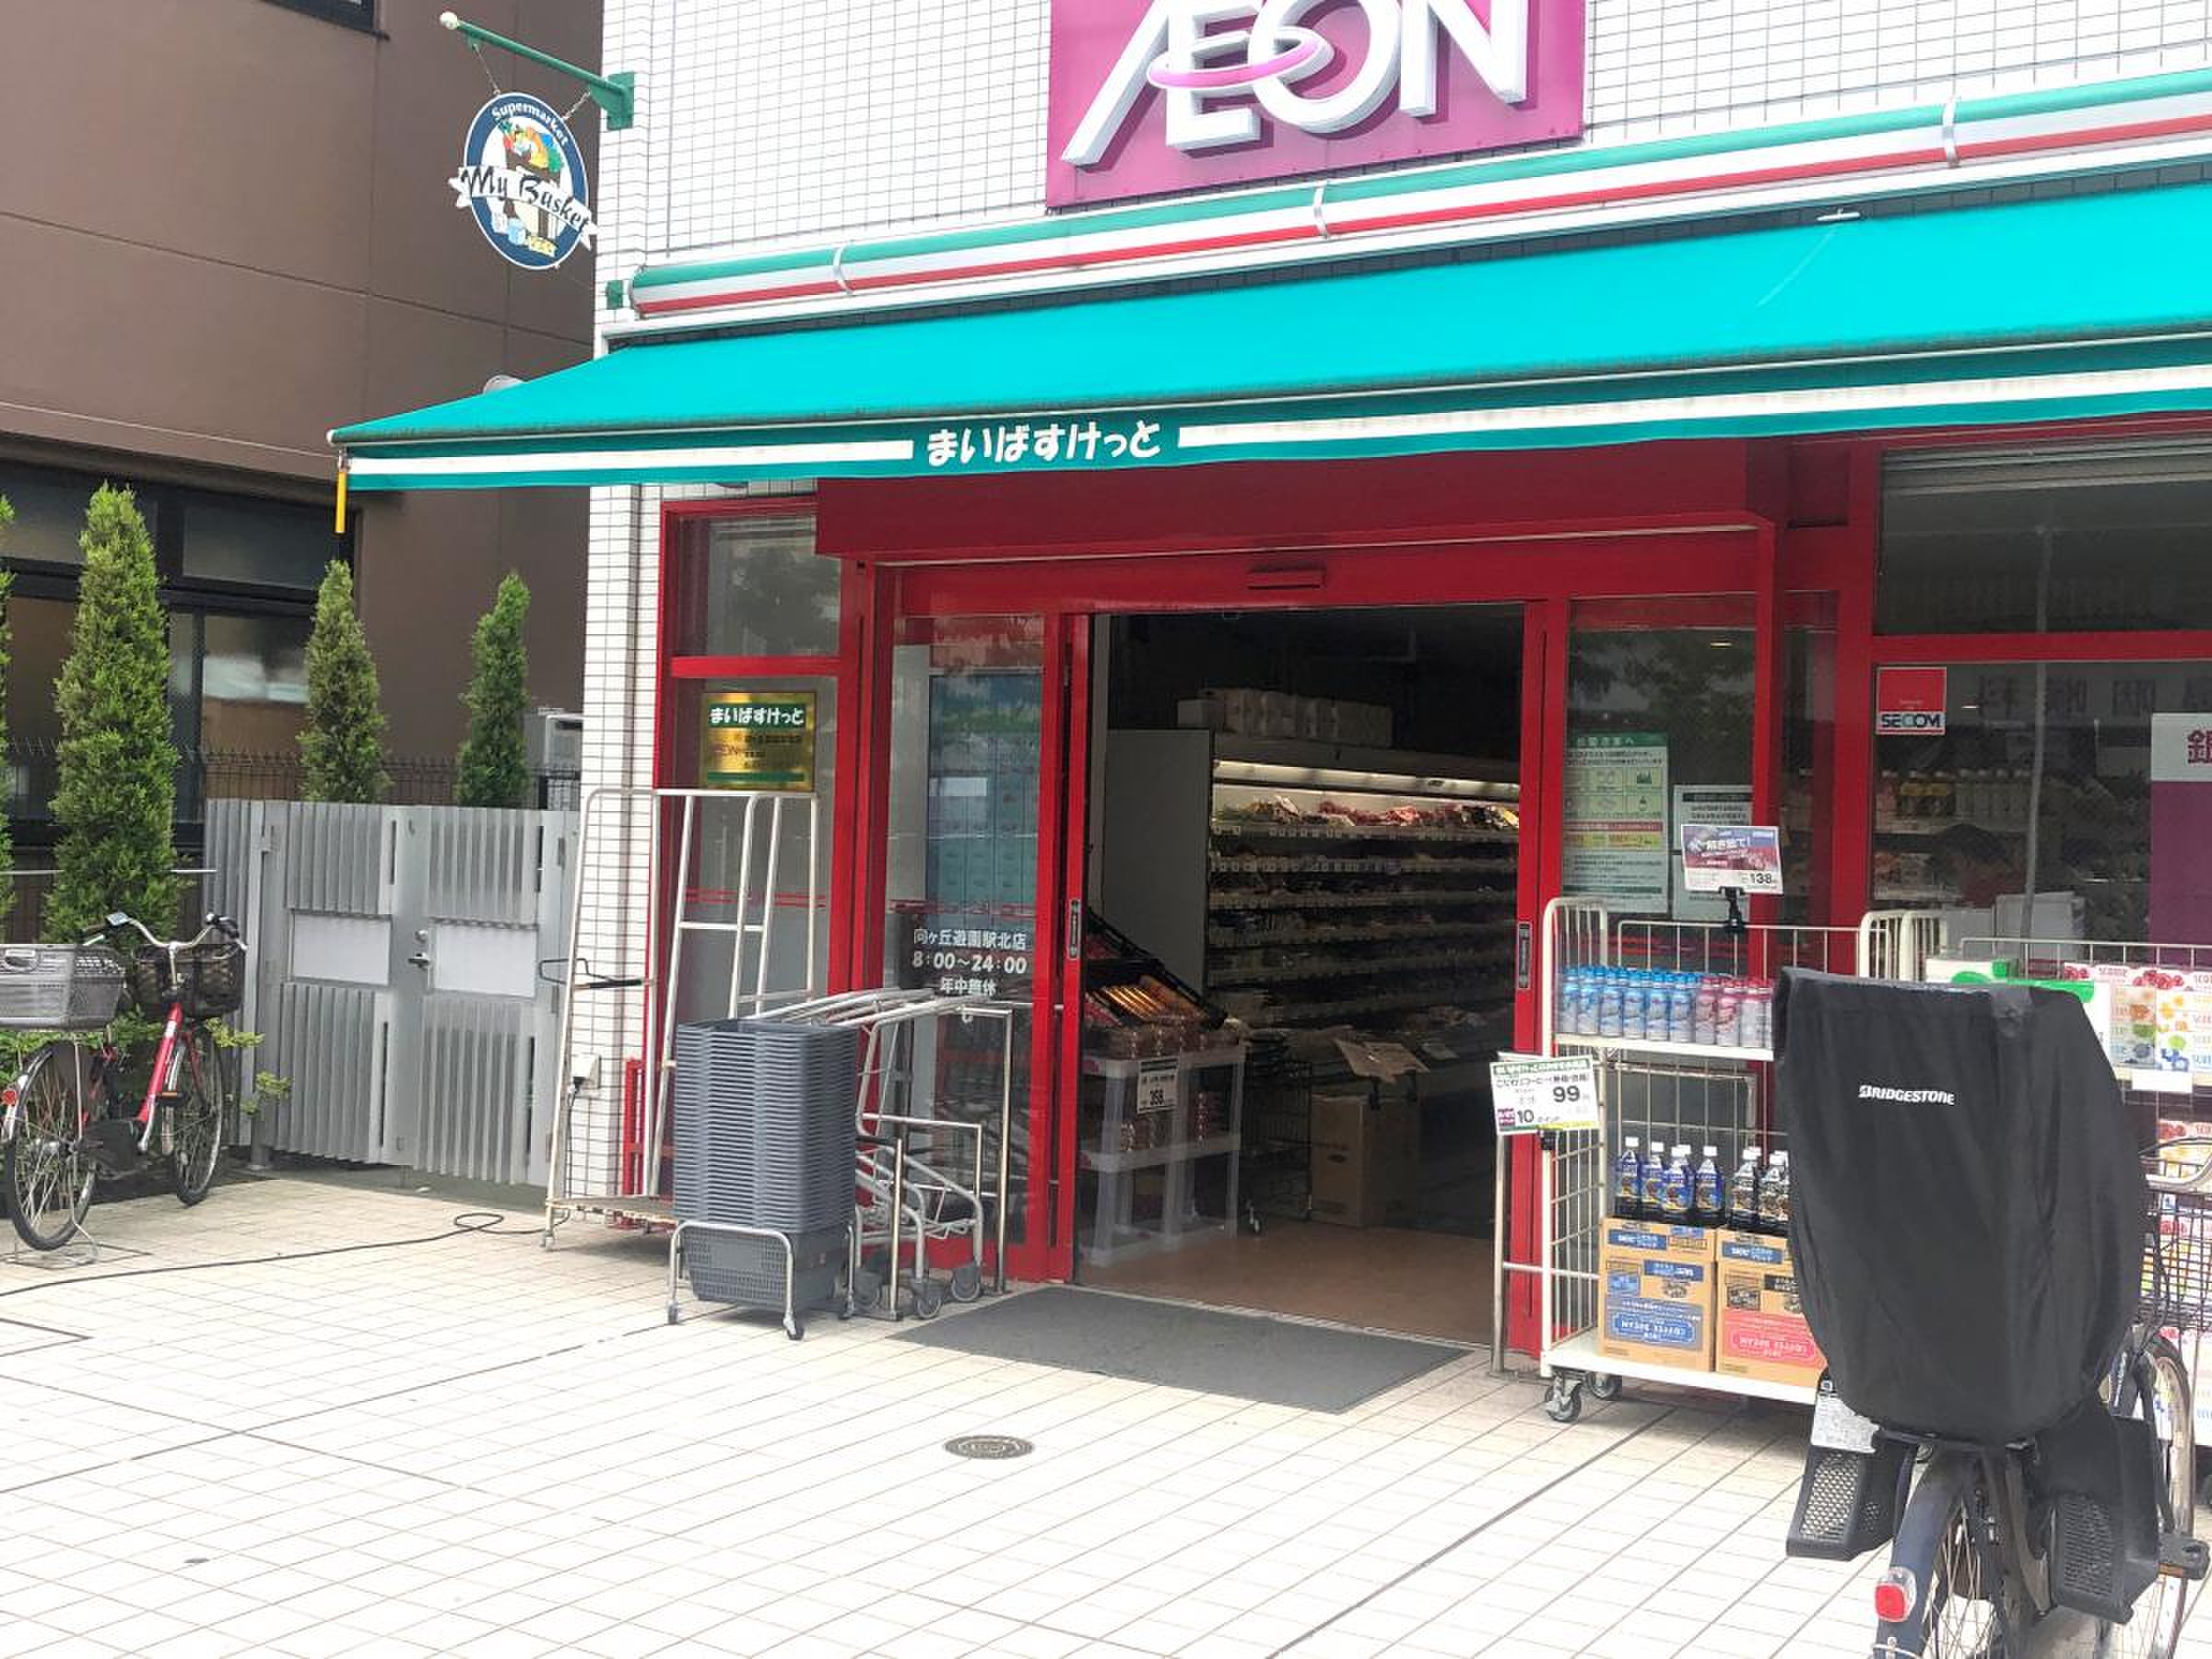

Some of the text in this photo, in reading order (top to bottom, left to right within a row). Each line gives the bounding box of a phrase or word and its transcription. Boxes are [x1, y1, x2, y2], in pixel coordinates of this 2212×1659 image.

[491, 102, 569, 146] Supermarket
[461, 166, 590, 230] My Basket
[927, 419, 1161, 466] まいばすけっと
[710, 707, 805, 725] まいばすけっと
[1881, 713, 1940, 727] SECOM
[940, 977, 997, 997] 年中無休
[1552, 1086, 1581, 1103] 99
[1858, 1085, 1955, 1106] BRIDGESTONE
